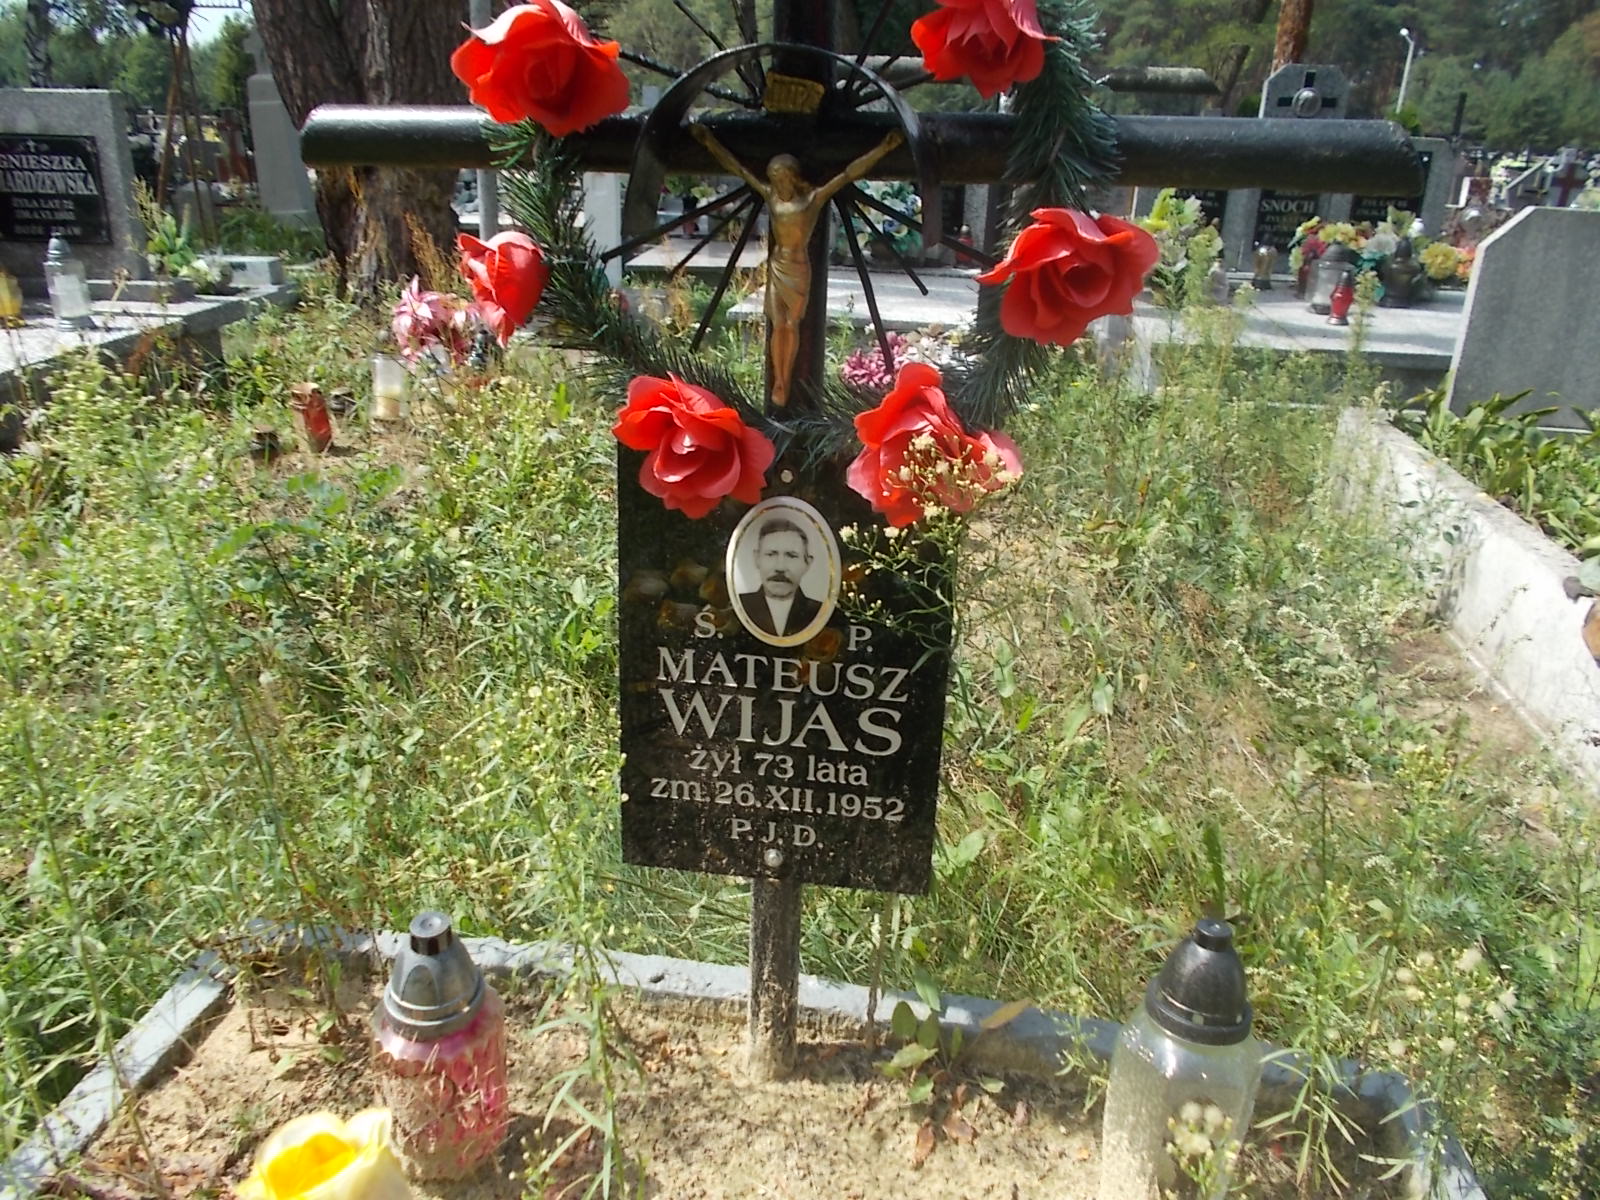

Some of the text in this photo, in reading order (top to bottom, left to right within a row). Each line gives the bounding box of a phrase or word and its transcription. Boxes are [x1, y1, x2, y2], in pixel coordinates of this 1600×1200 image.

[1260, 199, 1315, 213] SNOCH
[846, 624, 873, 653] P.
[656, 646, 911, 702] MATEUSZ
[658, 688, 903, 756] WIJAS
[688, 743, 869, 786] żył 73 lata
[730, 817, 754, 841] P.
[792, 824, 824, 849] D.
